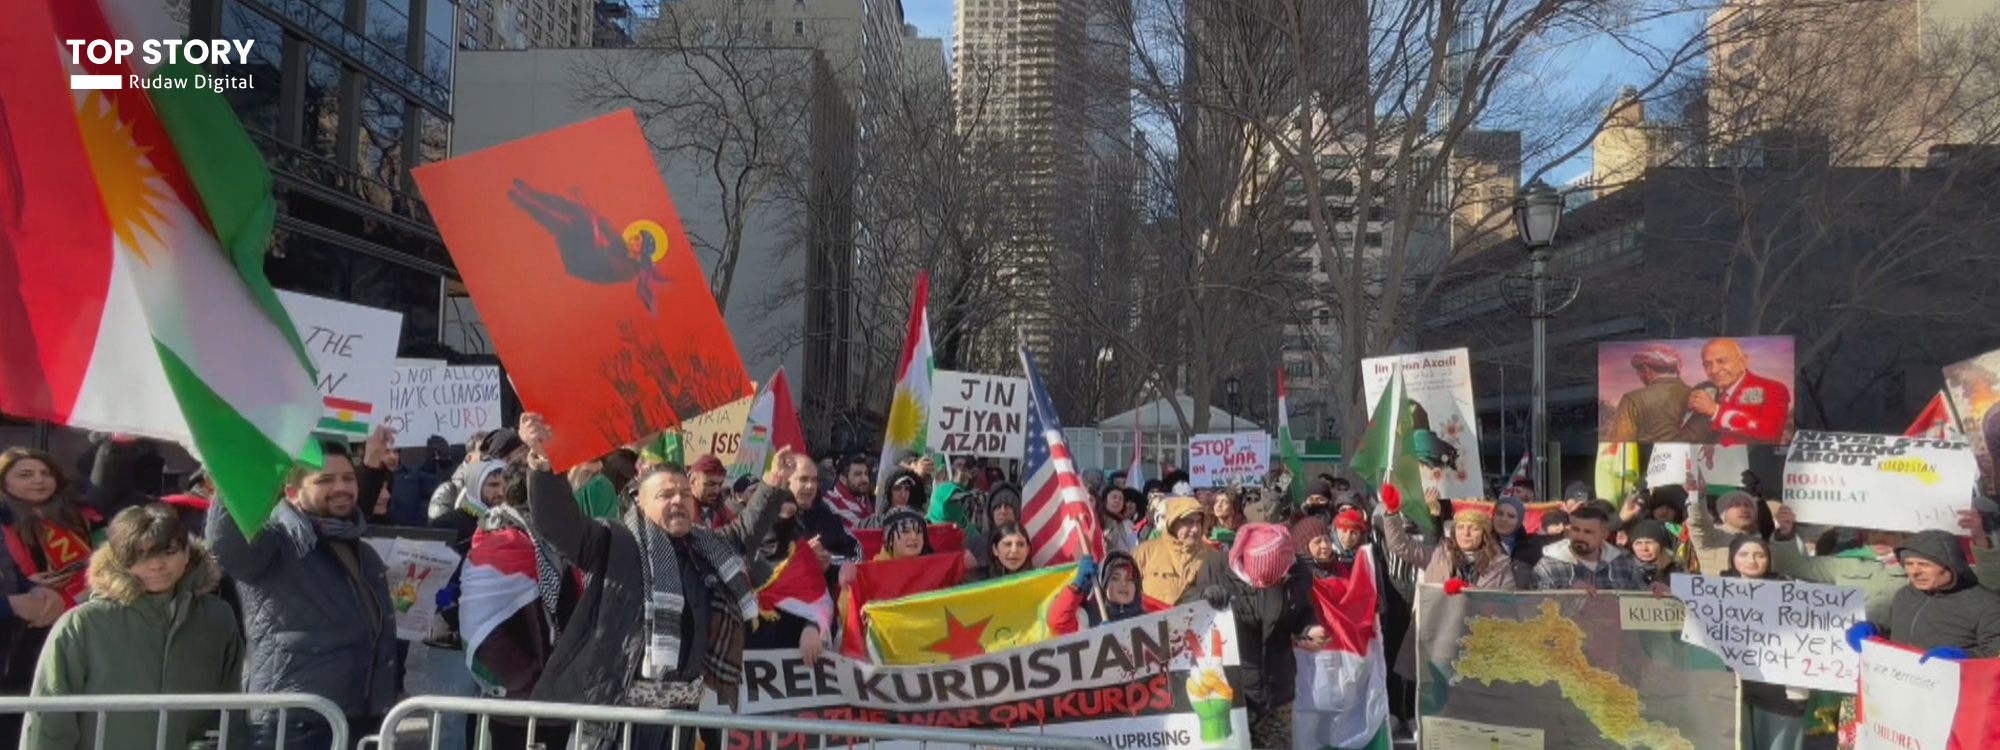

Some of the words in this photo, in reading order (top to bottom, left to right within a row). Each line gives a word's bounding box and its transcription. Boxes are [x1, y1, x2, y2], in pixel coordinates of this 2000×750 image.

[304, 325, 363, 358] THE
[408, 367, 433, 385] NOT
[443, 366, 499, 382] ALLOW
[960, 377, 1016, 407] JIN
[710, 431, 742, 457] ISIS
[940, 433, 1007, 453] AZADI
[1190, 437, 1235, 458] STOP
[1787, 450, 1878, 467] ABOUT
[1691, 576, 1765, 599] Bakur
[1780, 582, 1858, 608] Basur
[1686, 599, 1765, 625] Rojava
[852, 620, 1174, 704] KURDISTAN
[990, 699, 1047, 732] ON
[1053, 677, 1172, 712] KURDS
[1115, 730, 1191, 750] UPRISING
